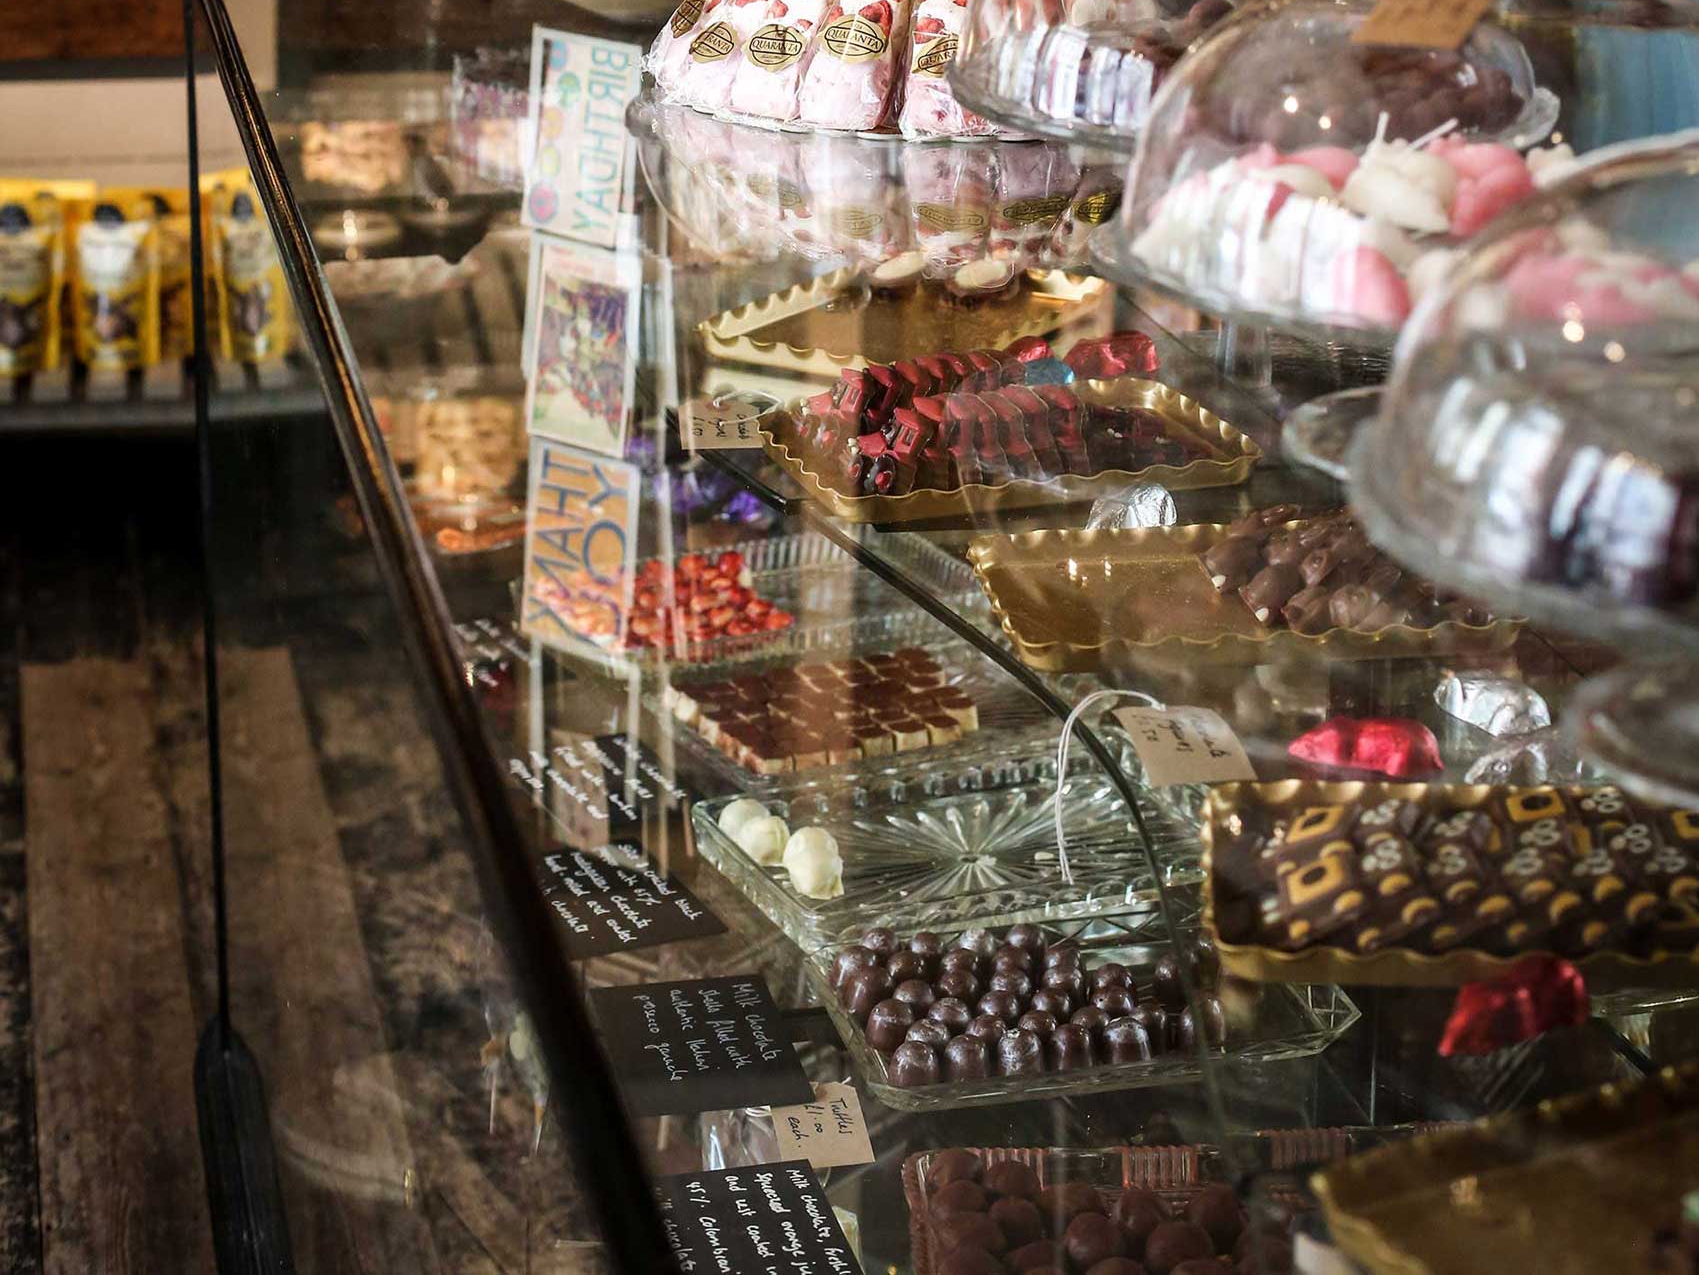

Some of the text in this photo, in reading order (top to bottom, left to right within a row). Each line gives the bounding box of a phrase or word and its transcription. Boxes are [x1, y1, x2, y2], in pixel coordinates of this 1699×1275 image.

[673, 898, 703, 921] black
[669, 988, 697, 1032] authentic
[731, 982, 783, 1061] Milk chocolate
[631, 993, 688, 1082] prosecco ganache
[704, 1019, 738, 1045] filled
[725, 1045, 754, 1069] with
[786, 1168, 811, 1190] Milk
[746, 1225, 775, 1259] coated
[780, 1220, 805, 1258] orange
